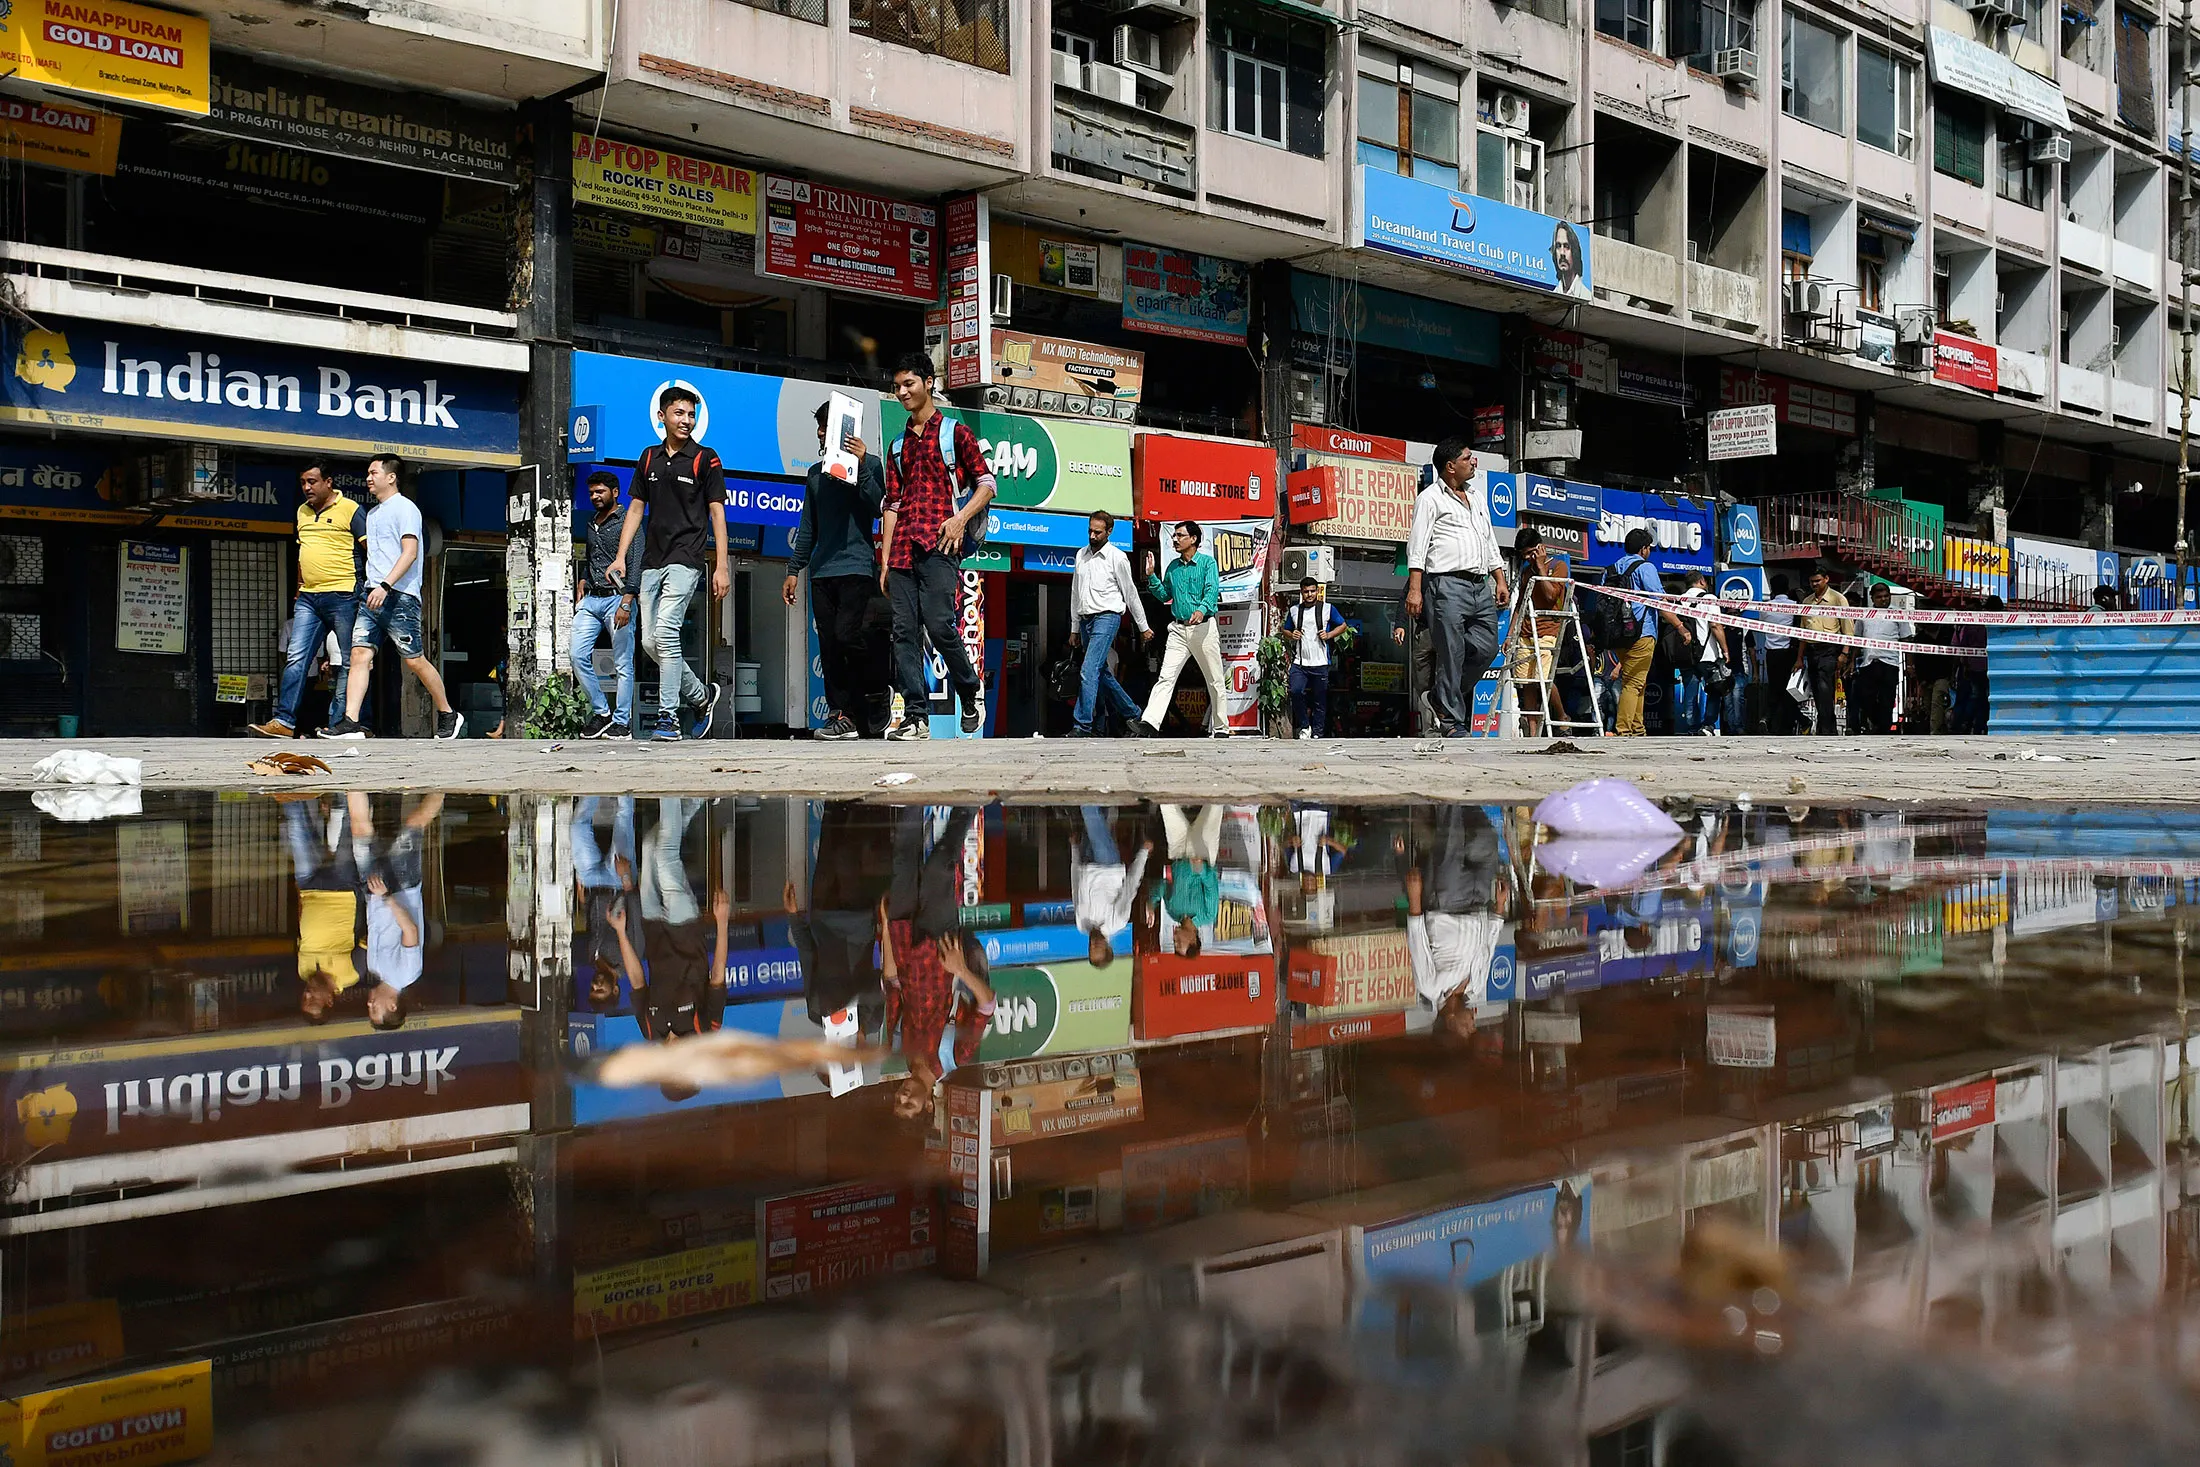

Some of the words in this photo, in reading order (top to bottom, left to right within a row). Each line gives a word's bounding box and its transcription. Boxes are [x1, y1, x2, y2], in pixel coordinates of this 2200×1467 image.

[45, 1, 182, 43] MANAPPURAM
[49, 25, 112, 50] GOLD
[119, 44, 179, 66] LOAN
[121, 75, 142, 86] Central
[159, 82, 175, 93] Nehru
[30, 106, 90, 132] LOAN
[211, 75, 299, 119] Starlit
[304, 95, 453, 148] Creations
[230, 110, 283, 132] PRAGATI
[573, 135, 660, 175] APTOP
[666, 154, 752, 196] REPAIR
[133, 165, 171, 179] PRAGATI
[233, 183, 262, 195] NEHRU
[602, 169, 664, 193] ROCKET
[668, 182, 714, 203] SALES
[591, 193, 604, 204] PH:
[594, 183, 611, 194] Rose
[612, 187, 640, 201] Building
[663, 196, 684, 208] Nehru
[685, 201, 704, 213] Place,
[705, 205, 720, 215] New
[721, 208, 748, 221] Delhi-19
[813, 188, 893, 222] TRINITY
[573, 215, 631, 238] SALES
[804, 208, 817, 217] AIR
[818, 210, 843, 222] TRAVEL
[852, 217, 873, 228] TOURS
[827, 241, 841, 252] ONE
[843, 244, 860, 254] STOP
[862, 248, 880, 258] SHOP
[1371, 214, 1437, 244] Dreamland
[1441, 232, 1475, 252] Travel
[1478, 241, 1504, 261] Club
[1507, 250, 1523, 267] (P)
[1526, 254, 1547, 272] Ltd.
[812, 254, 822, 264] AIR
[877, 266, 896, 277] CENTRE
[1042, 341, 1055, 355] MX
[1057, 345, 1076, 360] MDR
[1078, 348, 1125, 367] Technologies
[1067, 364, 1092, 374] FACTORY
[1093, 368, 1113, 377] OUTLET
[1619, 369, 1643, 381] LAPTOP
[1646, 374, 1667, 385] REPAIR
[102, 340, 302, 413] Indian
[316, 365, 459, 429] Bank
[373, 443, 399, 454] NEHRU
[403, 445, 428, 456] PLACE
[1329, 434, 1372, 453] Canon
[32, 464, 82, 490] बैंक
[1069, 461, 1123, 478] ELECTRONICS
[1159, 478, 1177, 493] THE
[1180, 480, 1245, 499] MOBILESTORE
[1334, 466, 1364, 496] BILE
[1368, 469, 1417, 502] REPAIR
[1532, 483, 1568, 502] ASUS
[757, 492, 804, 513] Galax
[1292, 491, 1311, 503] MOBILE
[1495, 494, 1510, 504] DELL
[1338, 497, 1365, 524] TOP
[175, 517, 212, 528] NEHRU
[214, 520, 249, 530] PLACE
[1002, 521, 1027, 532] Certified
[1027, 523, 1050, 533] Reseller
[1369, 527, 1385, 538] DATA
[1736, 528, 1755, 540] DELL
[728, 536, 756, 547] arketing
[1038, 551, 1076, 568] vivo
[1214, 533, 1231, 572] 10
[2019, 552, 2036, 569] Dell
[2038, 555, 2069, 573] Retailer
[1723, 588, 1750, 600] DELL
[1476, 692, 1494, 701] viv
